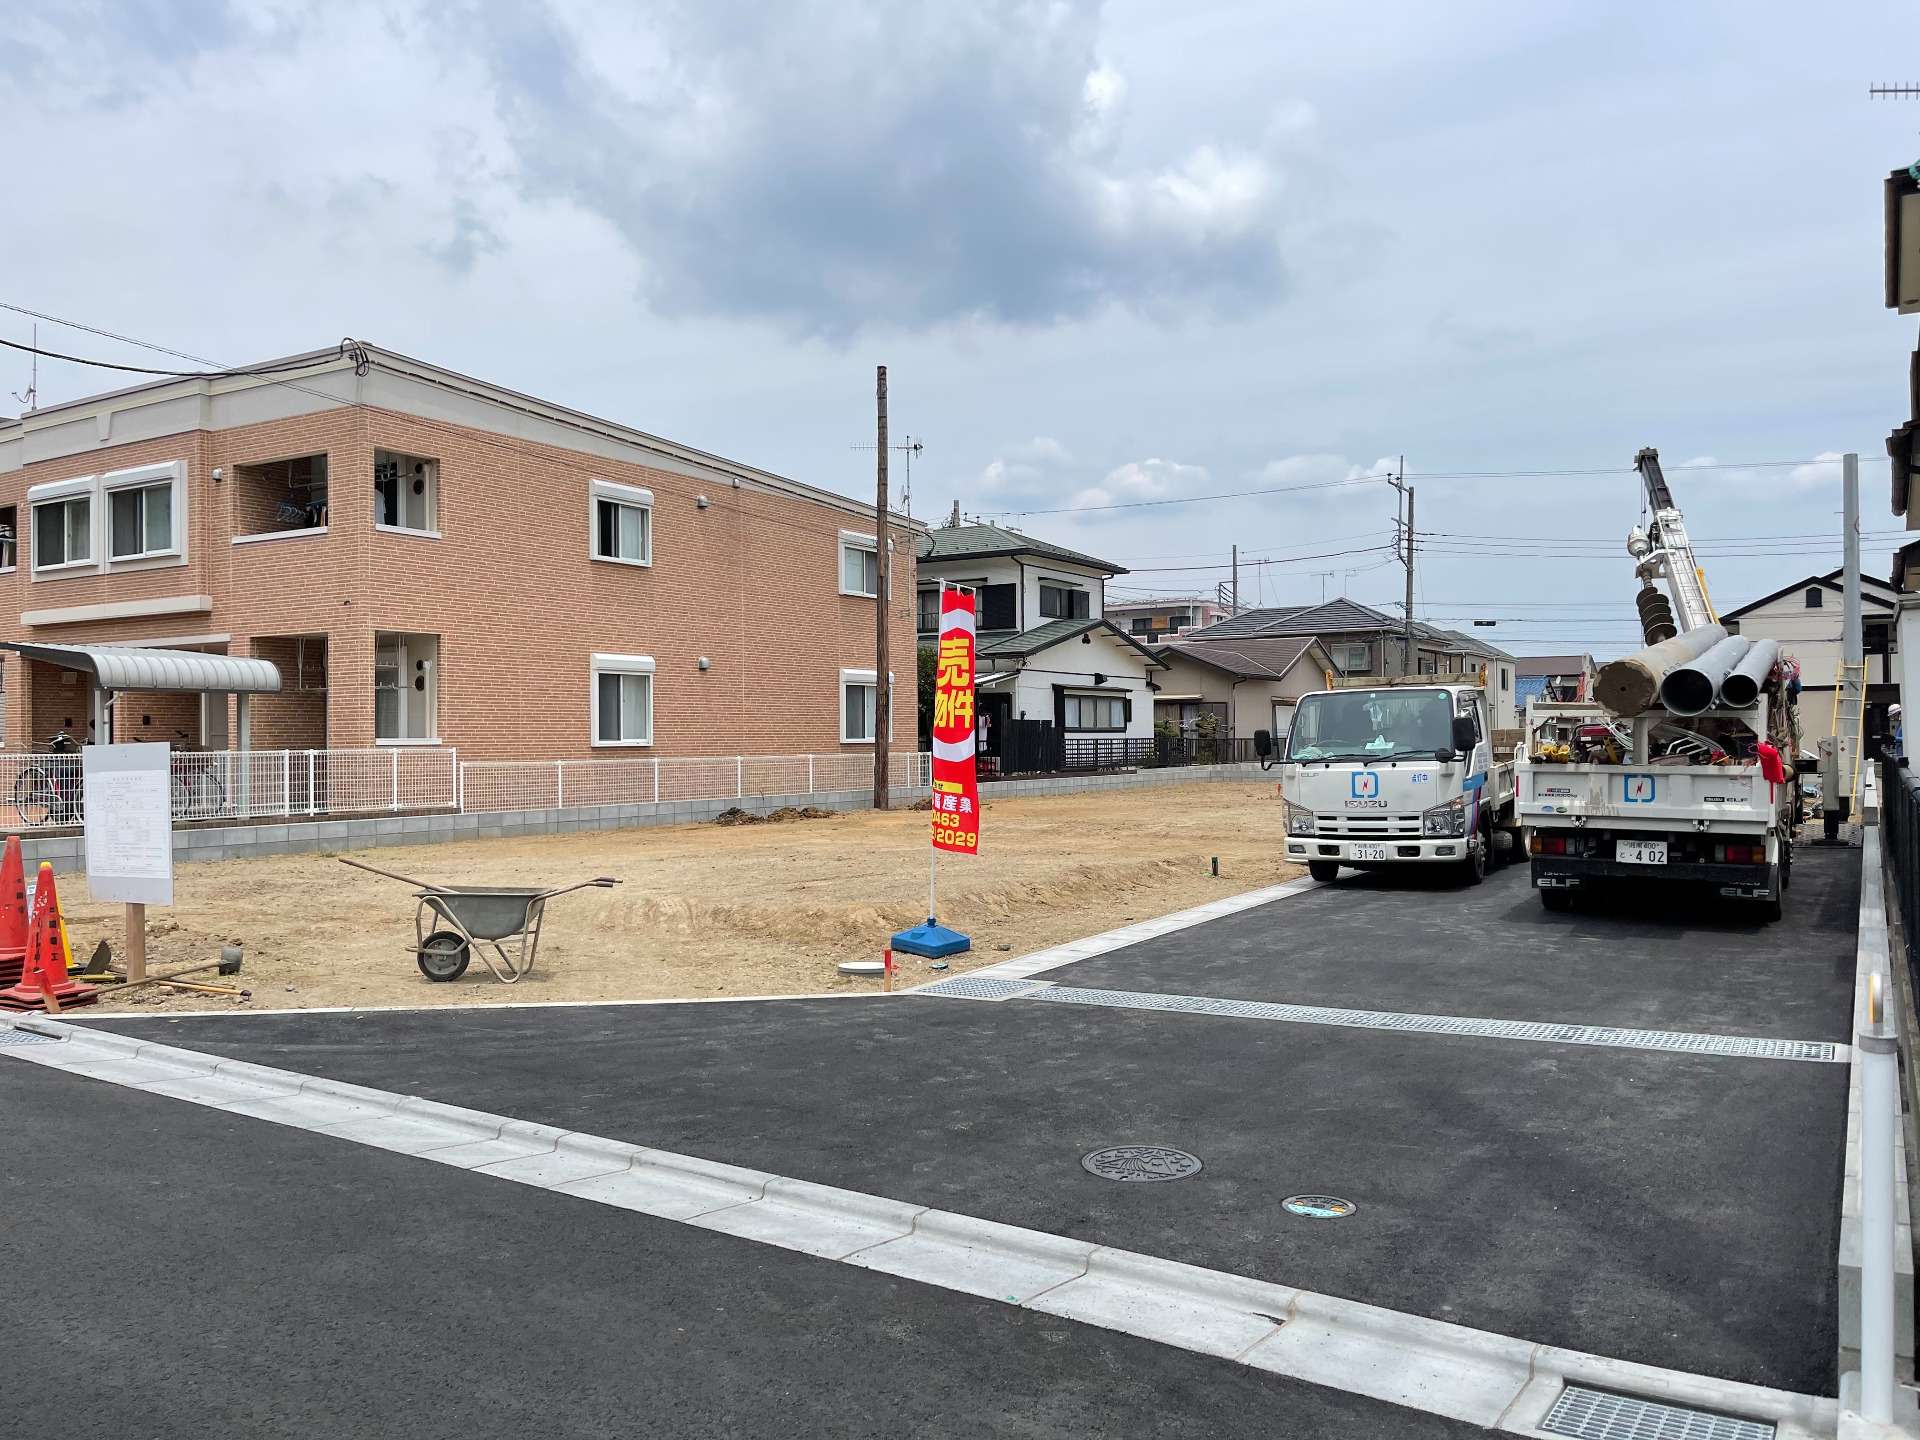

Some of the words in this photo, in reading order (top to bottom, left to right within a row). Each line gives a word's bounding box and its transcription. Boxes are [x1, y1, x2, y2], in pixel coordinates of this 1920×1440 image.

[937, 637, 970, 687] 売
[1344, 800, 1388, 809] ISUZU
[1357, 849, 1384, 860] 31-20
[1537, 878, 1580, 888] ELF
[1719, 887, 1770, 898] ELF
